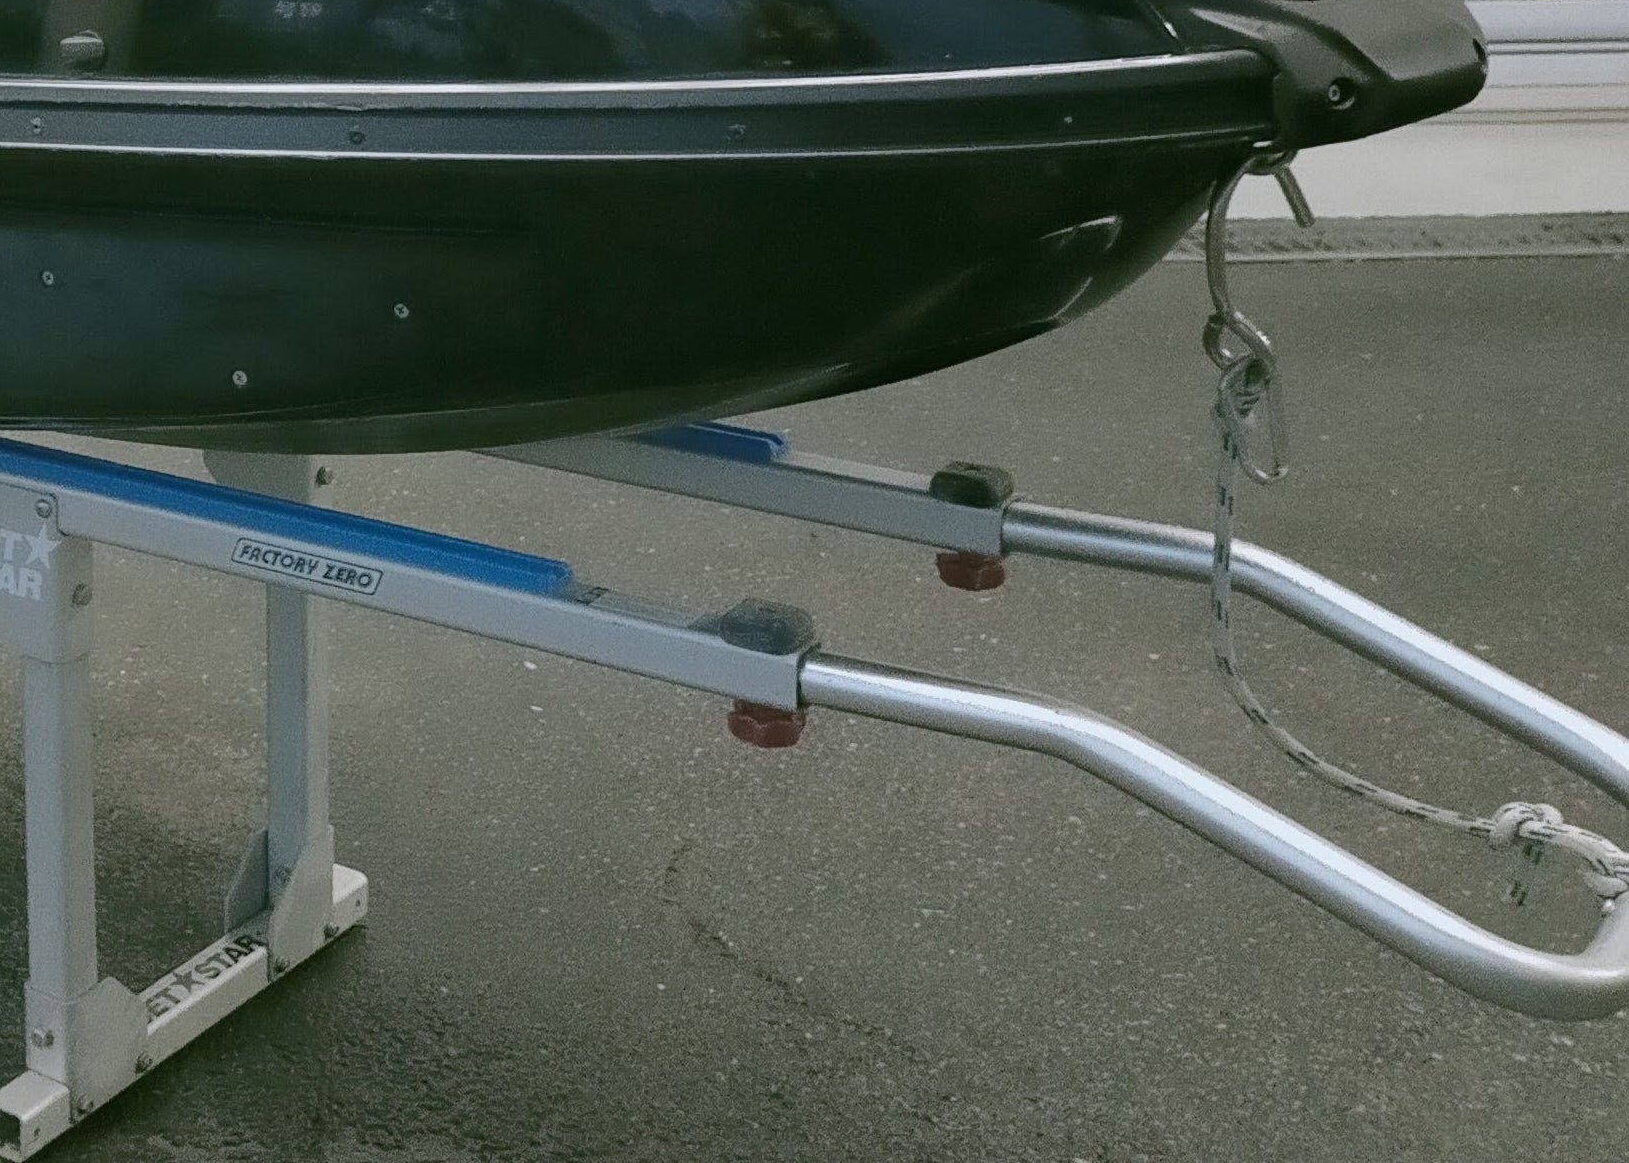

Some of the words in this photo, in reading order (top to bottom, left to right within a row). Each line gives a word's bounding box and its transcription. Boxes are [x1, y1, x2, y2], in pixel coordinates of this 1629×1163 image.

[239, 545, 319, 575] FACTORY
[323, 565, 373, 587] ZERO
[145, 988, 180, 1024] ET
[195, 935, 268, 978] STAR
